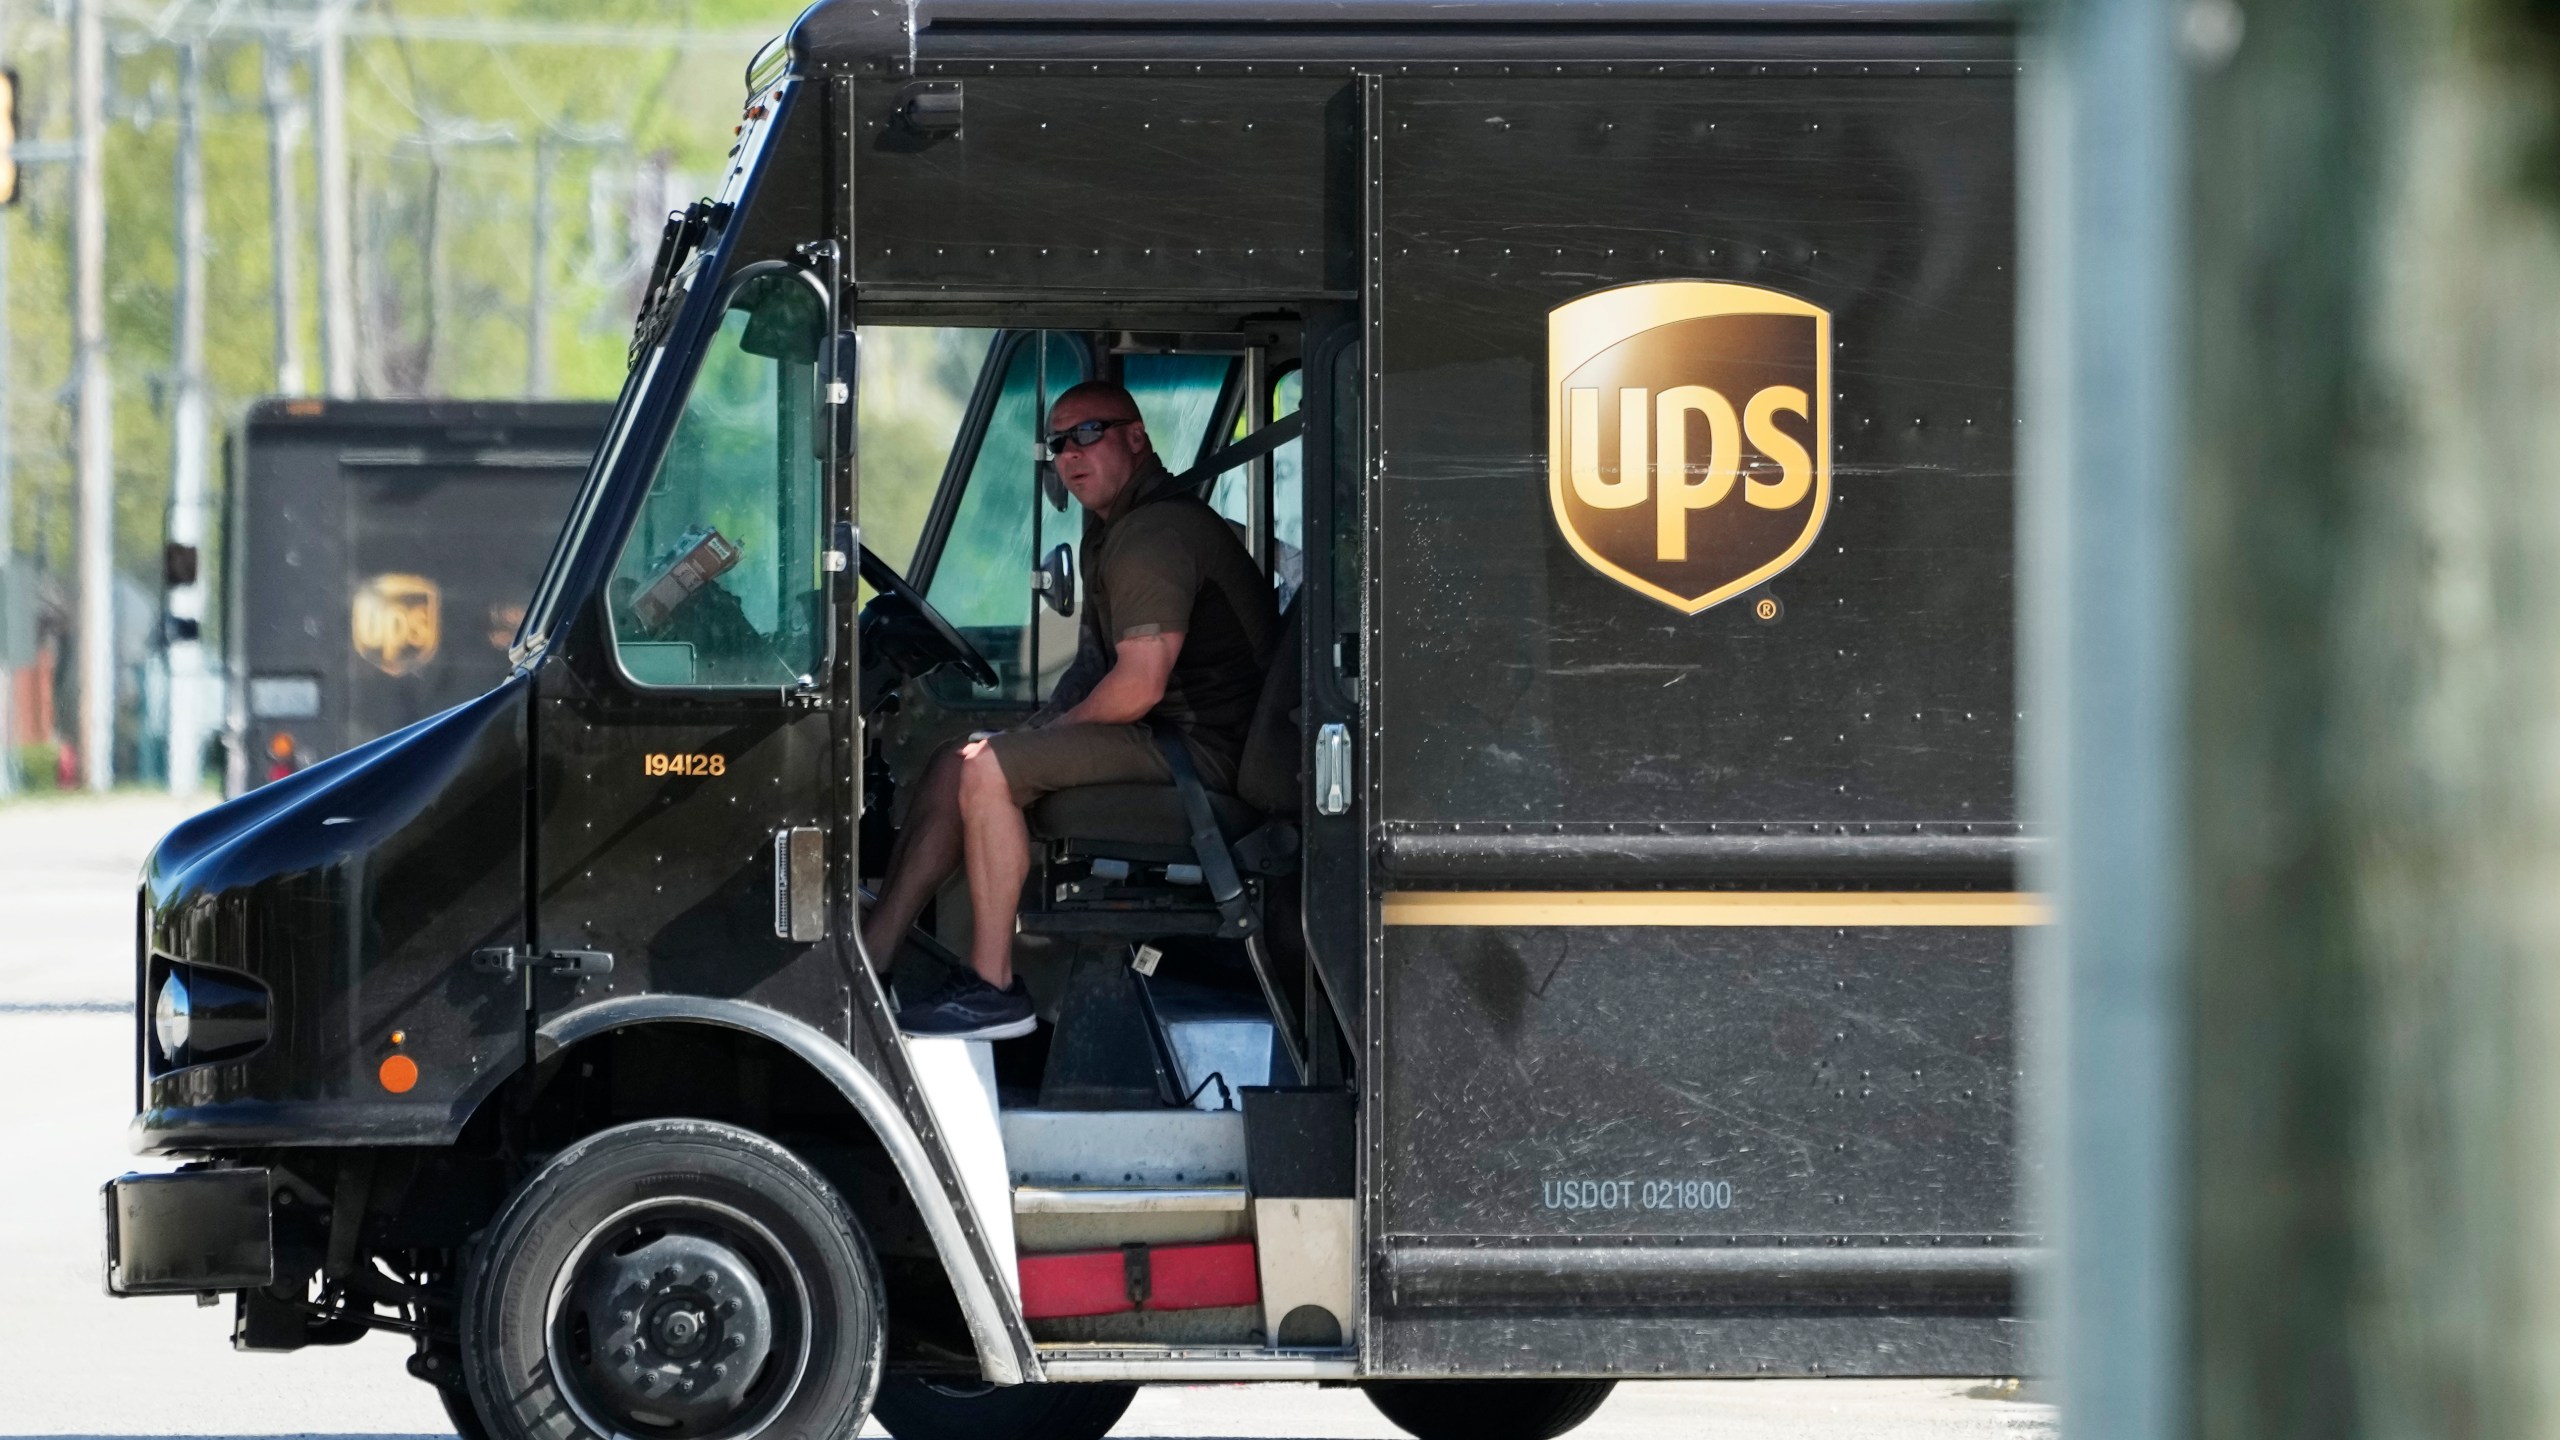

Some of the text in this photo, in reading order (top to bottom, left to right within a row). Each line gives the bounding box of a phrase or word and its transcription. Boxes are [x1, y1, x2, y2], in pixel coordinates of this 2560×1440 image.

[1570, 385, 1812, 562] ups
[645, 753, 726, 776] 194128
[1544, 1180, 1731, 1209] USDOT 021800
